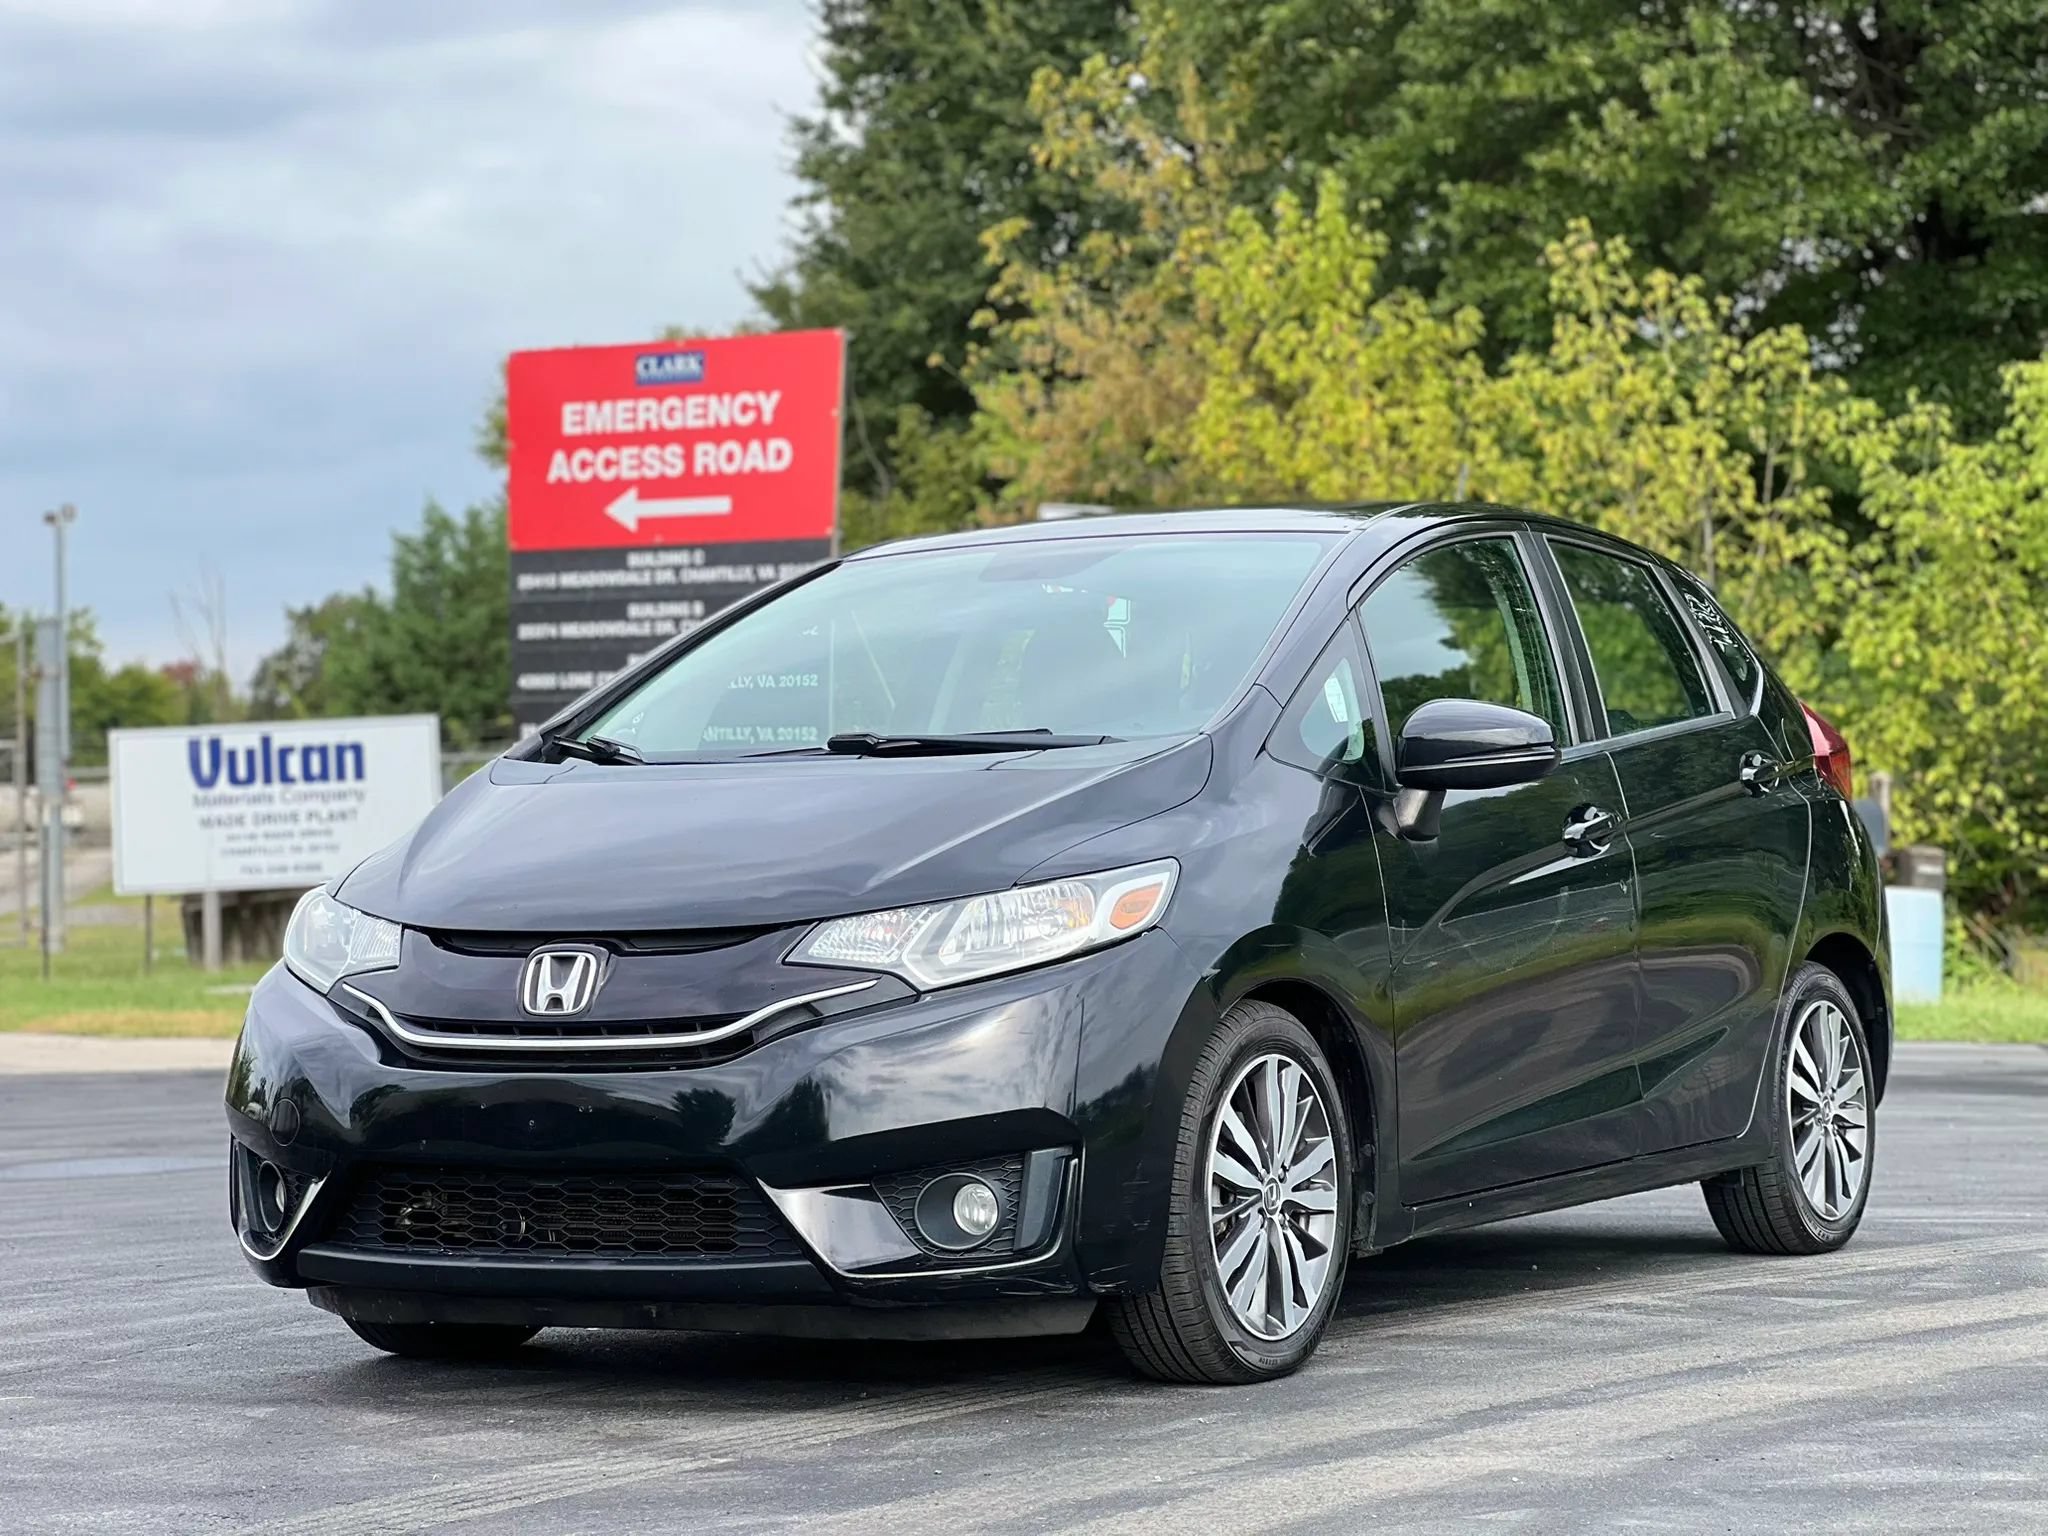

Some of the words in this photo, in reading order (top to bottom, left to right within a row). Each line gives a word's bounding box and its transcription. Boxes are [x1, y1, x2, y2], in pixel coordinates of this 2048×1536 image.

[636, 353, 702, 376] CLARK
[561, 390, 781, 437] EMERGENCY
[546, 445, 684, 484] ACCESS
[694, 438, 793, 476] ROAD
[627, 551, 688, 567] BUILDING
[627, 602, 688, 618] BUILDING
[757, 674, 776, 688] VA
[779, 673, 819, 688] 20152
[756, 726, 775, 742] VA
[777, 726, 818, 741] 20152
[188, 735, 365, 790] Vulcan
[192, 791, 275, 808] Materials
[280, 788, 366, 806] Company
[252, 811, 300, 828] DRIVE
[306, 808, 359, 825] PLANT
